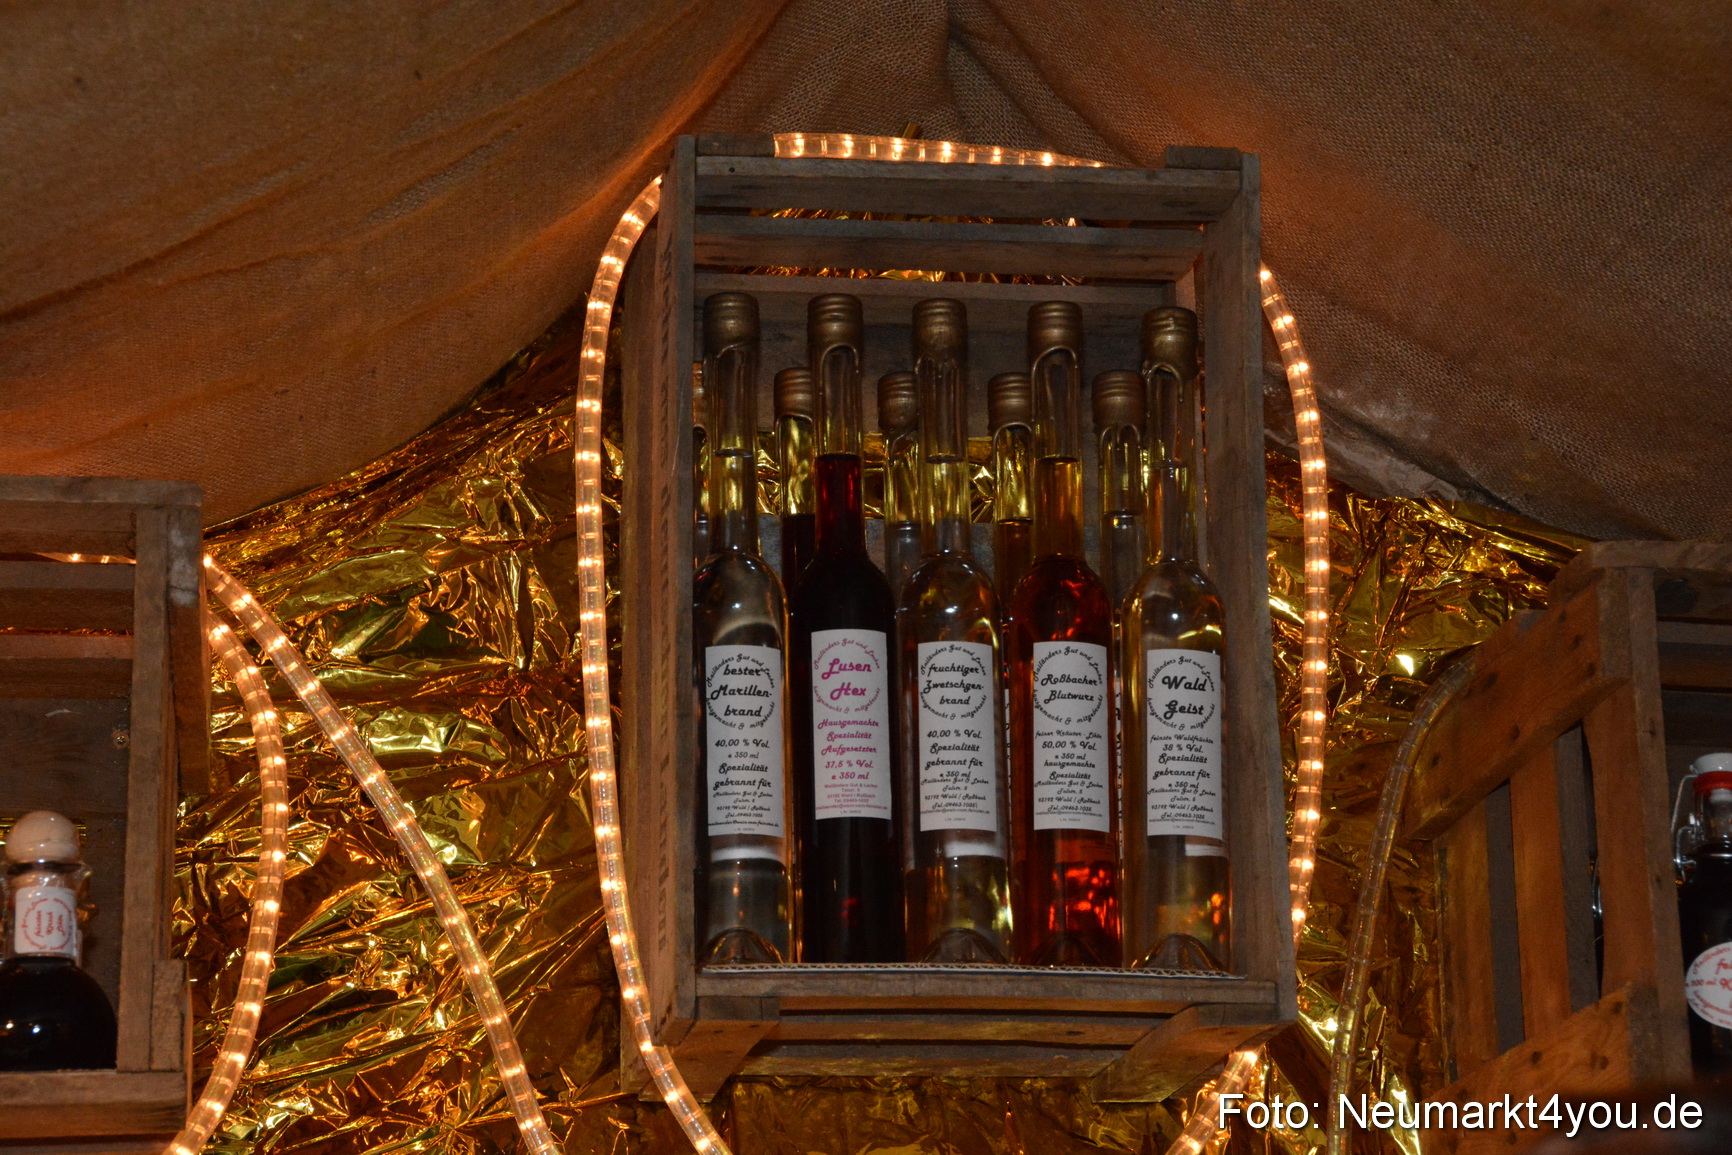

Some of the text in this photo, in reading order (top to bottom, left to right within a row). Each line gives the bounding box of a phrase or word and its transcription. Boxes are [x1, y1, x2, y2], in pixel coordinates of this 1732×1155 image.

[842, 638, 854, 646] Gut
[856, 642, 868, 650] und
[948, 644, 962, 653] Gut
[962, 648, 976, 656] und
[1064, 646, 1078, 656] Gut
[1080, 650, 1093, 660] und
[736, 653, 750, 662] Gut
[751, 658, 764, 666] und
[1178, 656, 1192, 665] Gut
[1192, 660, 1205, 670] und
[723, 664, 761, 676] bester
[821, 658, 872, 680] Lusen
[927, 662, 980, 678] fruchtiger
[1040, 674, 1098, 686] Roßbacher
[1161, 675, 1208, 692] Wald
[710, 684, 772, 700] Marillen-
[830, 681, 867, 701] Hex
[922, 680, 984, 694] Zwetschgen-
[939, 695, 971, 705] brand
[1044, 690, 1094, 704] Blutwurz
[724, 704, 762, 718] brand
[1163, 700, 1204, 720] Geist
[818, 718, 880, 730] Hausgemachte
[826, 730, 872, 742] Spezialität
[954, 729, 961, 737] %
[964, 729, 982, 738] Vol.
[1035, 730, 1054, 740] feiner
[1150, 734, 1172, 744] feinste
[742, 738, 750, 746] %
[752, 738, 770, 748] Vol.
[930, 742, 980, 754] Spezialität
[1070, 740, 1076, 748] %
[1080, 740, 1096, 751] Vol.
[1176, 744, 1183, 752] %
[1186, 744, 1204, 753] Vol.
[820, 744, 877, 756] Aufgesetzter
[846, 760, 853, 768] %
[856, 760, 874, 768] Vol.
[924, 757, 984, 770] gebrannt für
[1044, 760, 1096, 769] hausgemachte
[1158, 752, 1208, 765] Spezialität
[718, 762, 768, 775] Spezialität
[1152, 768, 1211, 780] gebrannt für
[839, 772, 856, 780] 350
[858, 772, 870, 780] ml
[1050, 770, 1091, 781] Spezialität
[712, 778, 772, 791] gebrannt für
